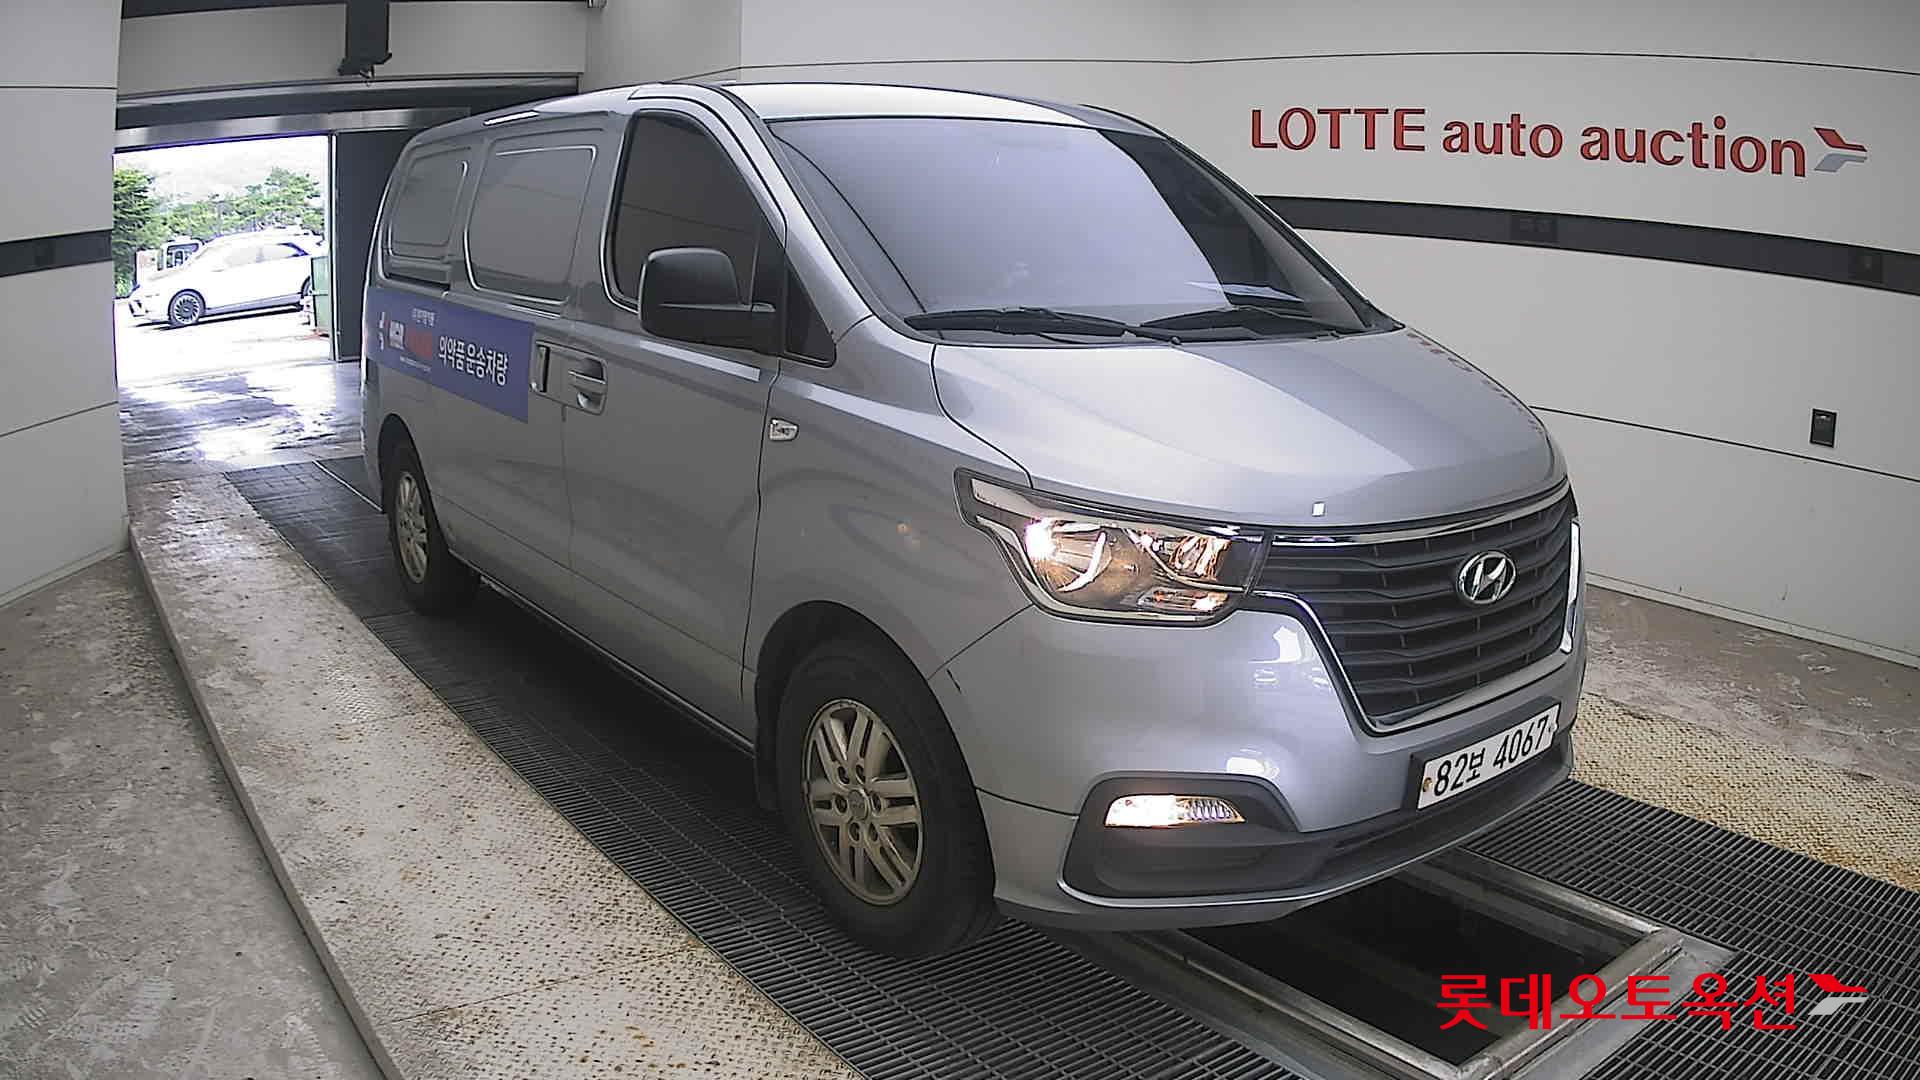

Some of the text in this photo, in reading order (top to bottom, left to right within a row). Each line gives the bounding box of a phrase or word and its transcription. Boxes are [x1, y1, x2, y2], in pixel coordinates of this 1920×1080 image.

[1251, 107, 1807, 178] LOTTE auto auction
[1493, 715, 1549, 769] 4067
